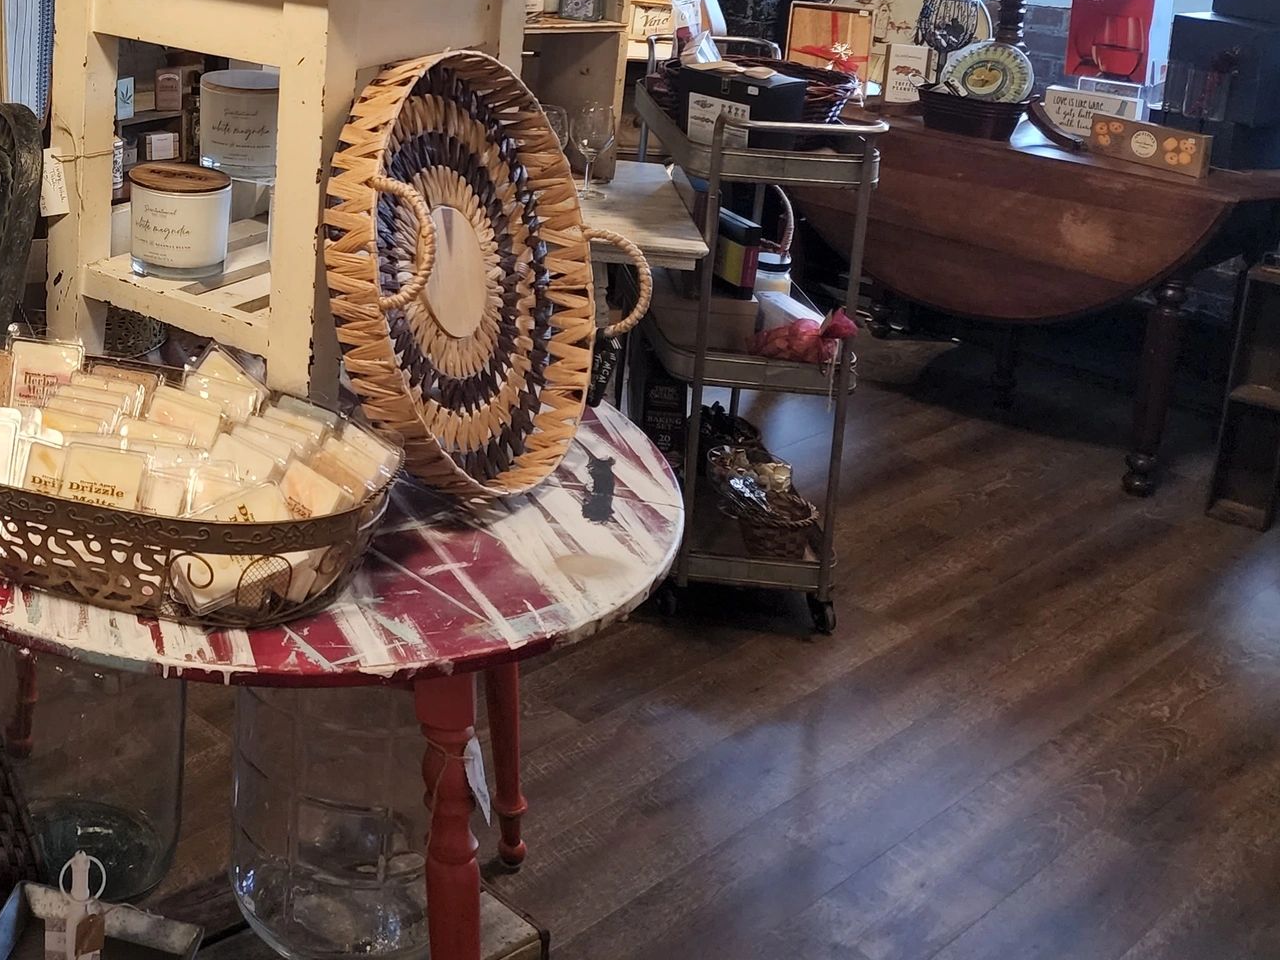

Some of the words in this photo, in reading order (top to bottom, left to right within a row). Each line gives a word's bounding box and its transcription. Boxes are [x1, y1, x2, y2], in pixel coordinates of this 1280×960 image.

[152, 224, 191, 241] magnolia
[24, 374, 59, 386] Herbal
[68, 481, 125, 498] Drizzle
